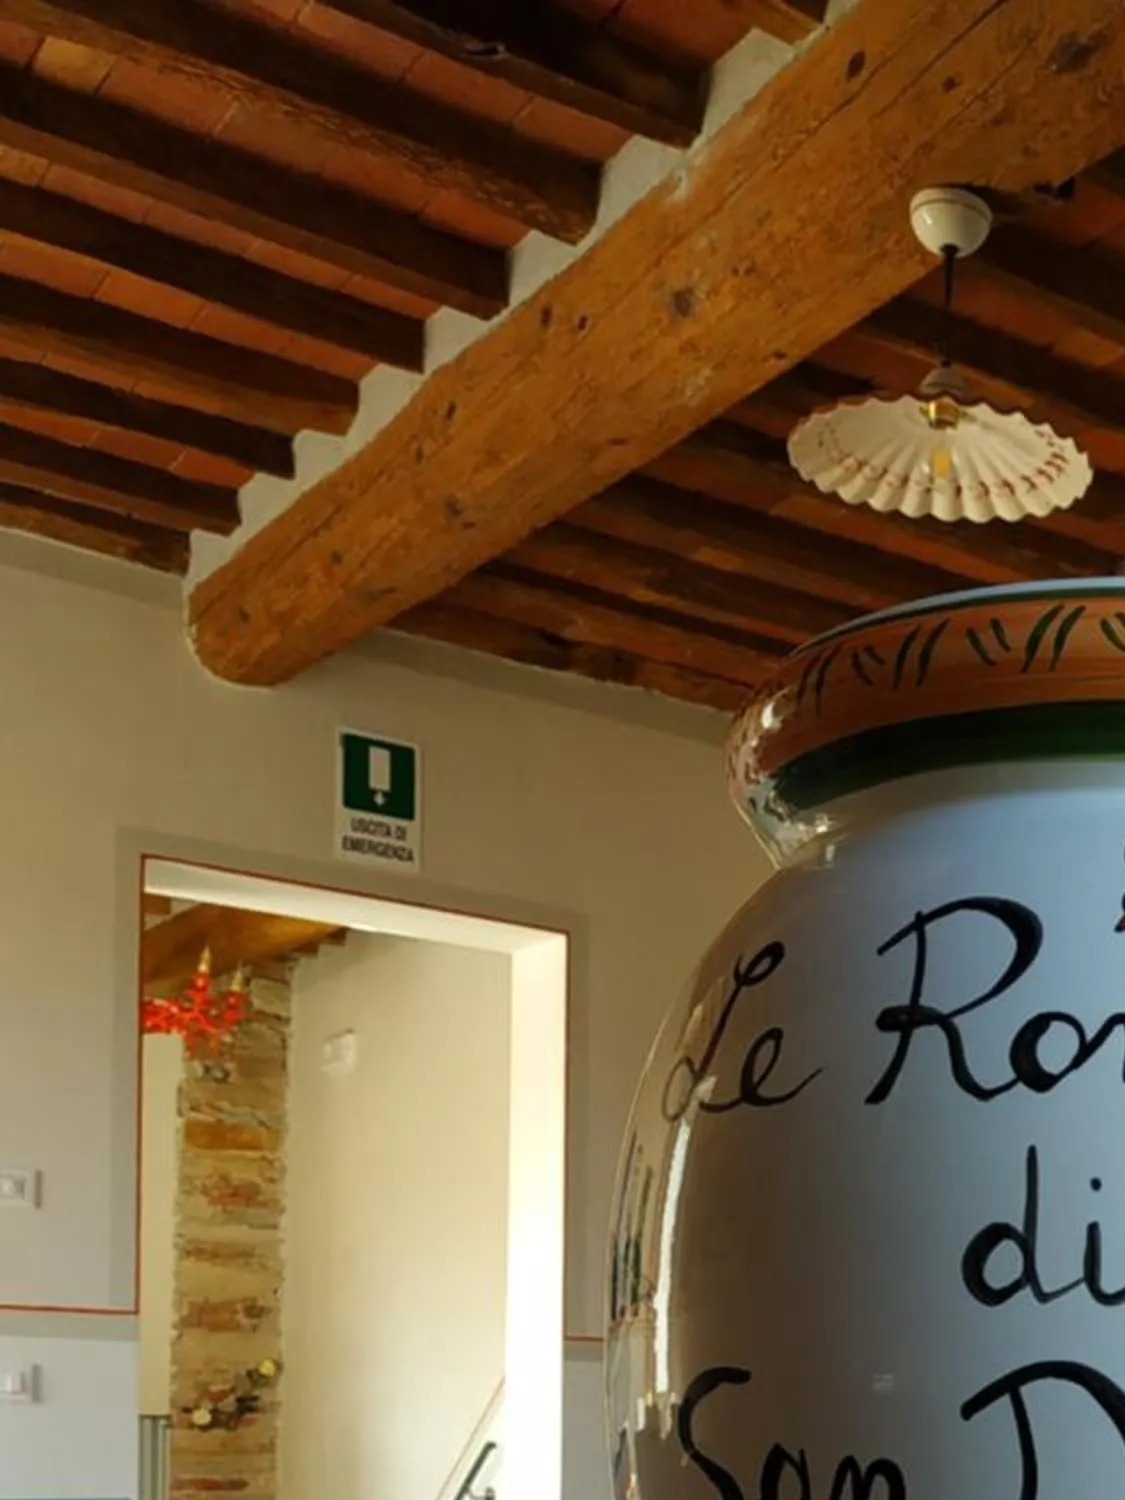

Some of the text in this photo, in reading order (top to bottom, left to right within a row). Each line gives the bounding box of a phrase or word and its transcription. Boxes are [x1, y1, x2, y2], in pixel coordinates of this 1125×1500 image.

[351, 817, 407, 841] USCITA DI
[341, 835, 414, 862] EMERGENZA
[661, 940, 823, 1122] Le
